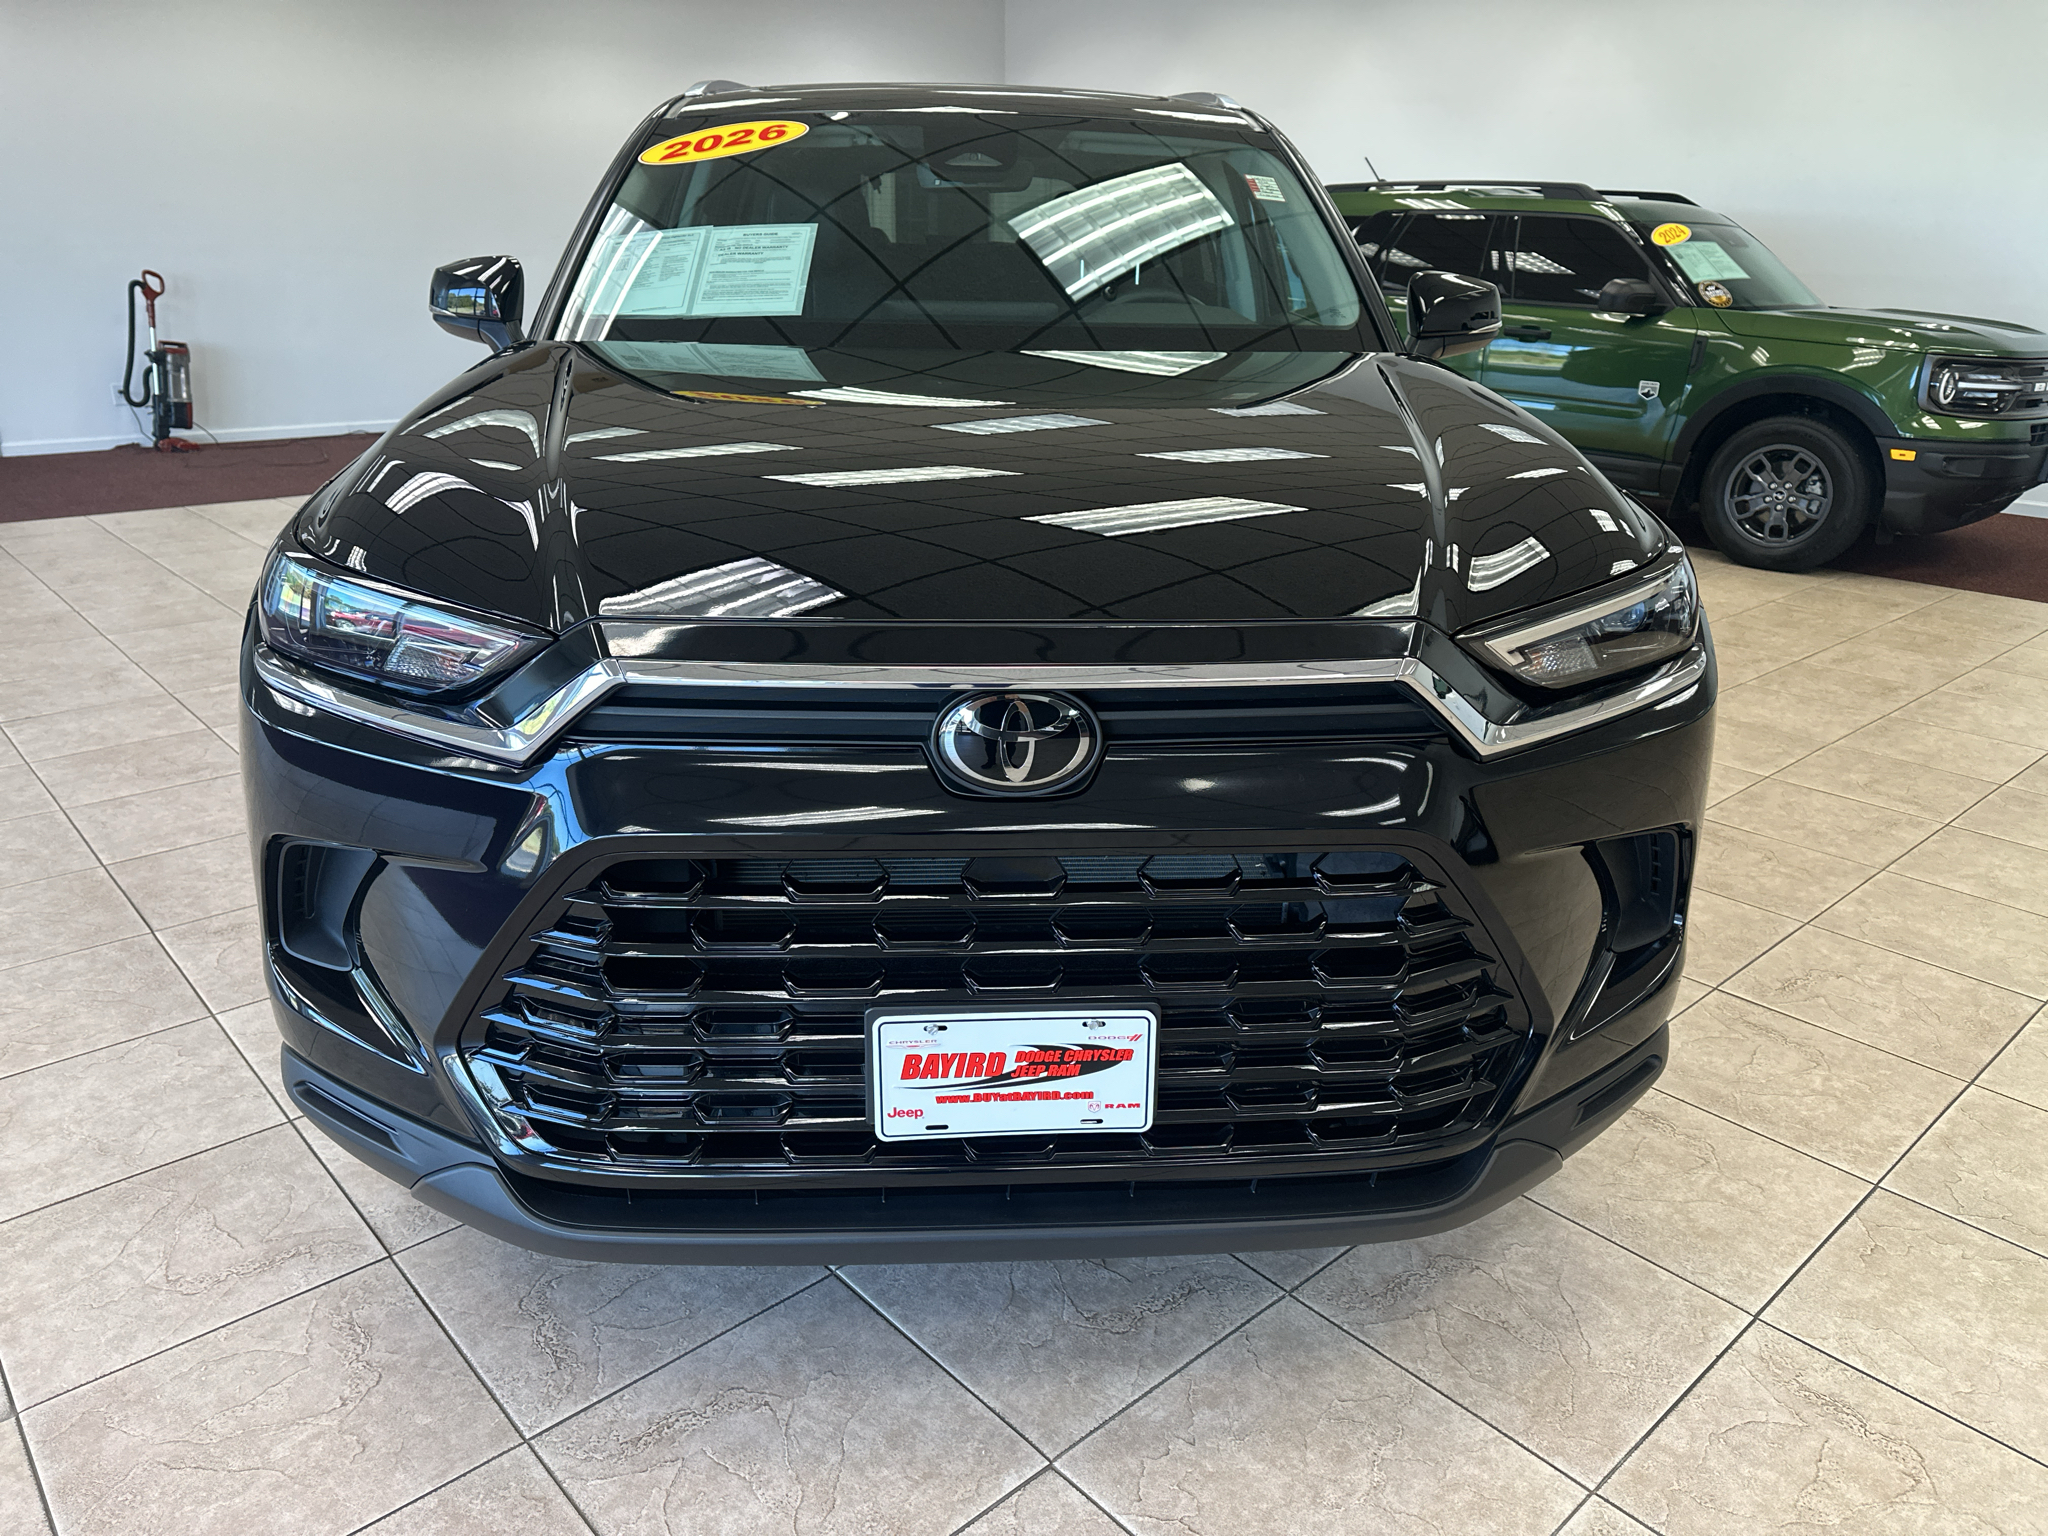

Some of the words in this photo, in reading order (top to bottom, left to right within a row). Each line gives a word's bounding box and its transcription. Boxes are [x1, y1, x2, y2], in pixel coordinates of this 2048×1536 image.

[658, 124, 789, 161] 2026
[1659, 225, 1687, 243] 2024
[1014, 1050, 1062, 1063] DODGE
[1064, 1049, 1134, 1062] CHRYSLER
[900, 1052, 1007, 1080] BAYIRD
[1011, 1065, 1046, 1078] JEEP
[1047, 1064, 1081, 1076] RAM
[935, 1091, 1094, 1104] www.BUYatBAYIRD.com
[887, 1107, 924, 1120] Jeep
